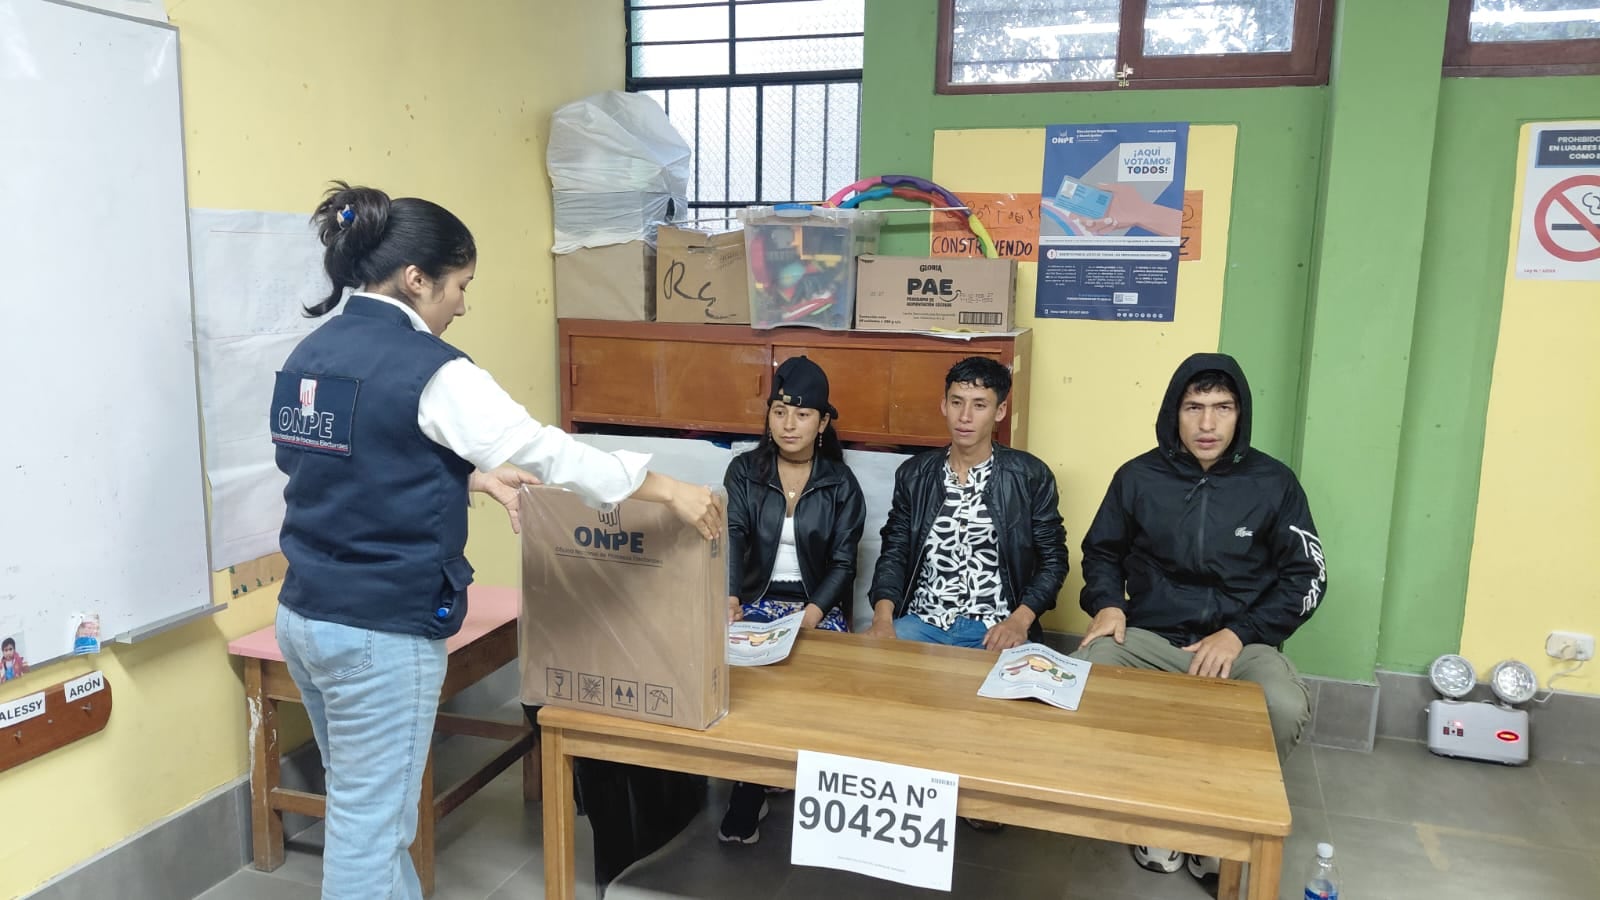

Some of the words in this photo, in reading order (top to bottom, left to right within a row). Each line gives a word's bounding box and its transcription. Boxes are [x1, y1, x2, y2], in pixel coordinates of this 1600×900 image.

[1052, 136, 1074, 144] ONPE
[1134, 147, 1160, 157] ¡AQUÍ
[1124, 158, 1171, 166] VOTAMOS
[1127, 166, 1168, 174] TODOS!
[919, 264, 943, 273] GLORIA
[907, 278, 954, 296] PAE
[279, 406, 335, 439] ONPE
[574, 526, 645, 554] ONPE
[70, 677, 100, 698] ARÓN
[0, 699, 43, 721] ALESSY
[818, 770, 898, 804] MESA
[798, 796, 948, 852] 904254
